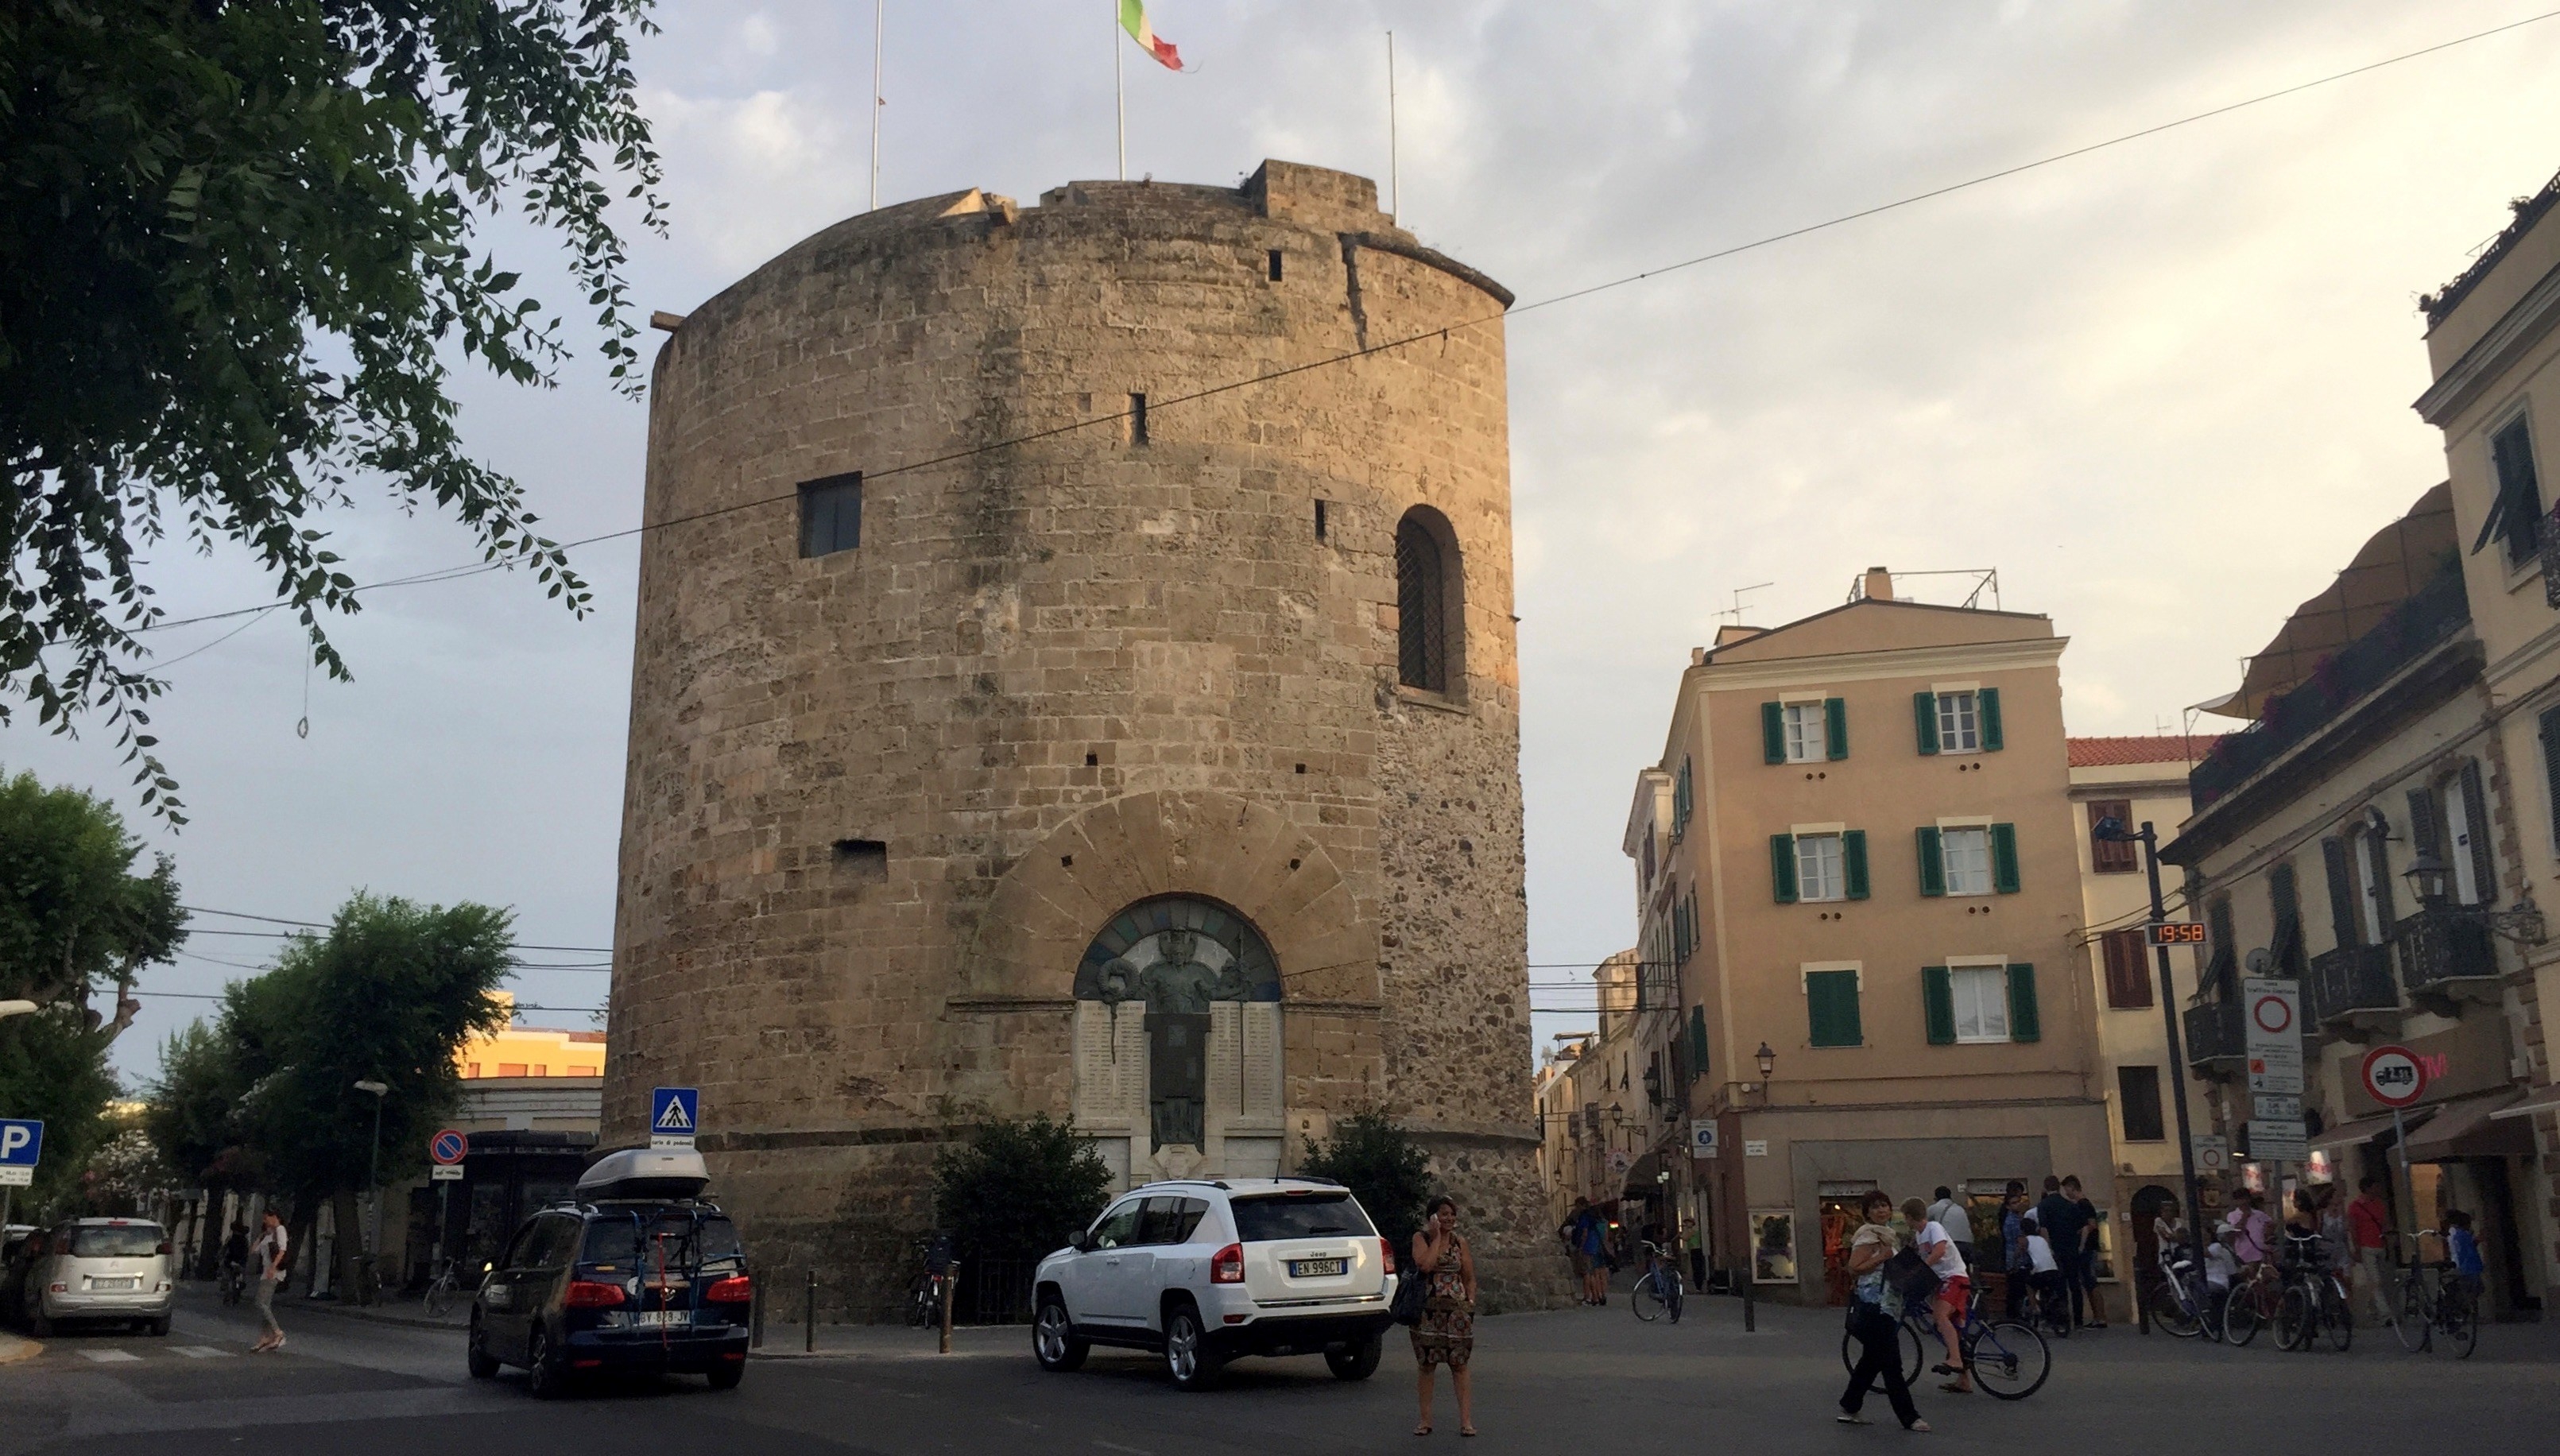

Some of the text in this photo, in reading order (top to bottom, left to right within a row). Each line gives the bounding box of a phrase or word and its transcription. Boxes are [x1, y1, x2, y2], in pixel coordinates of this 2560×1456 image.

[2158, 924, 2204, 942] 19:58
[1, 1125, 31, 1159] P
[1298, 1260, 1341, 1275] EN 996CT
